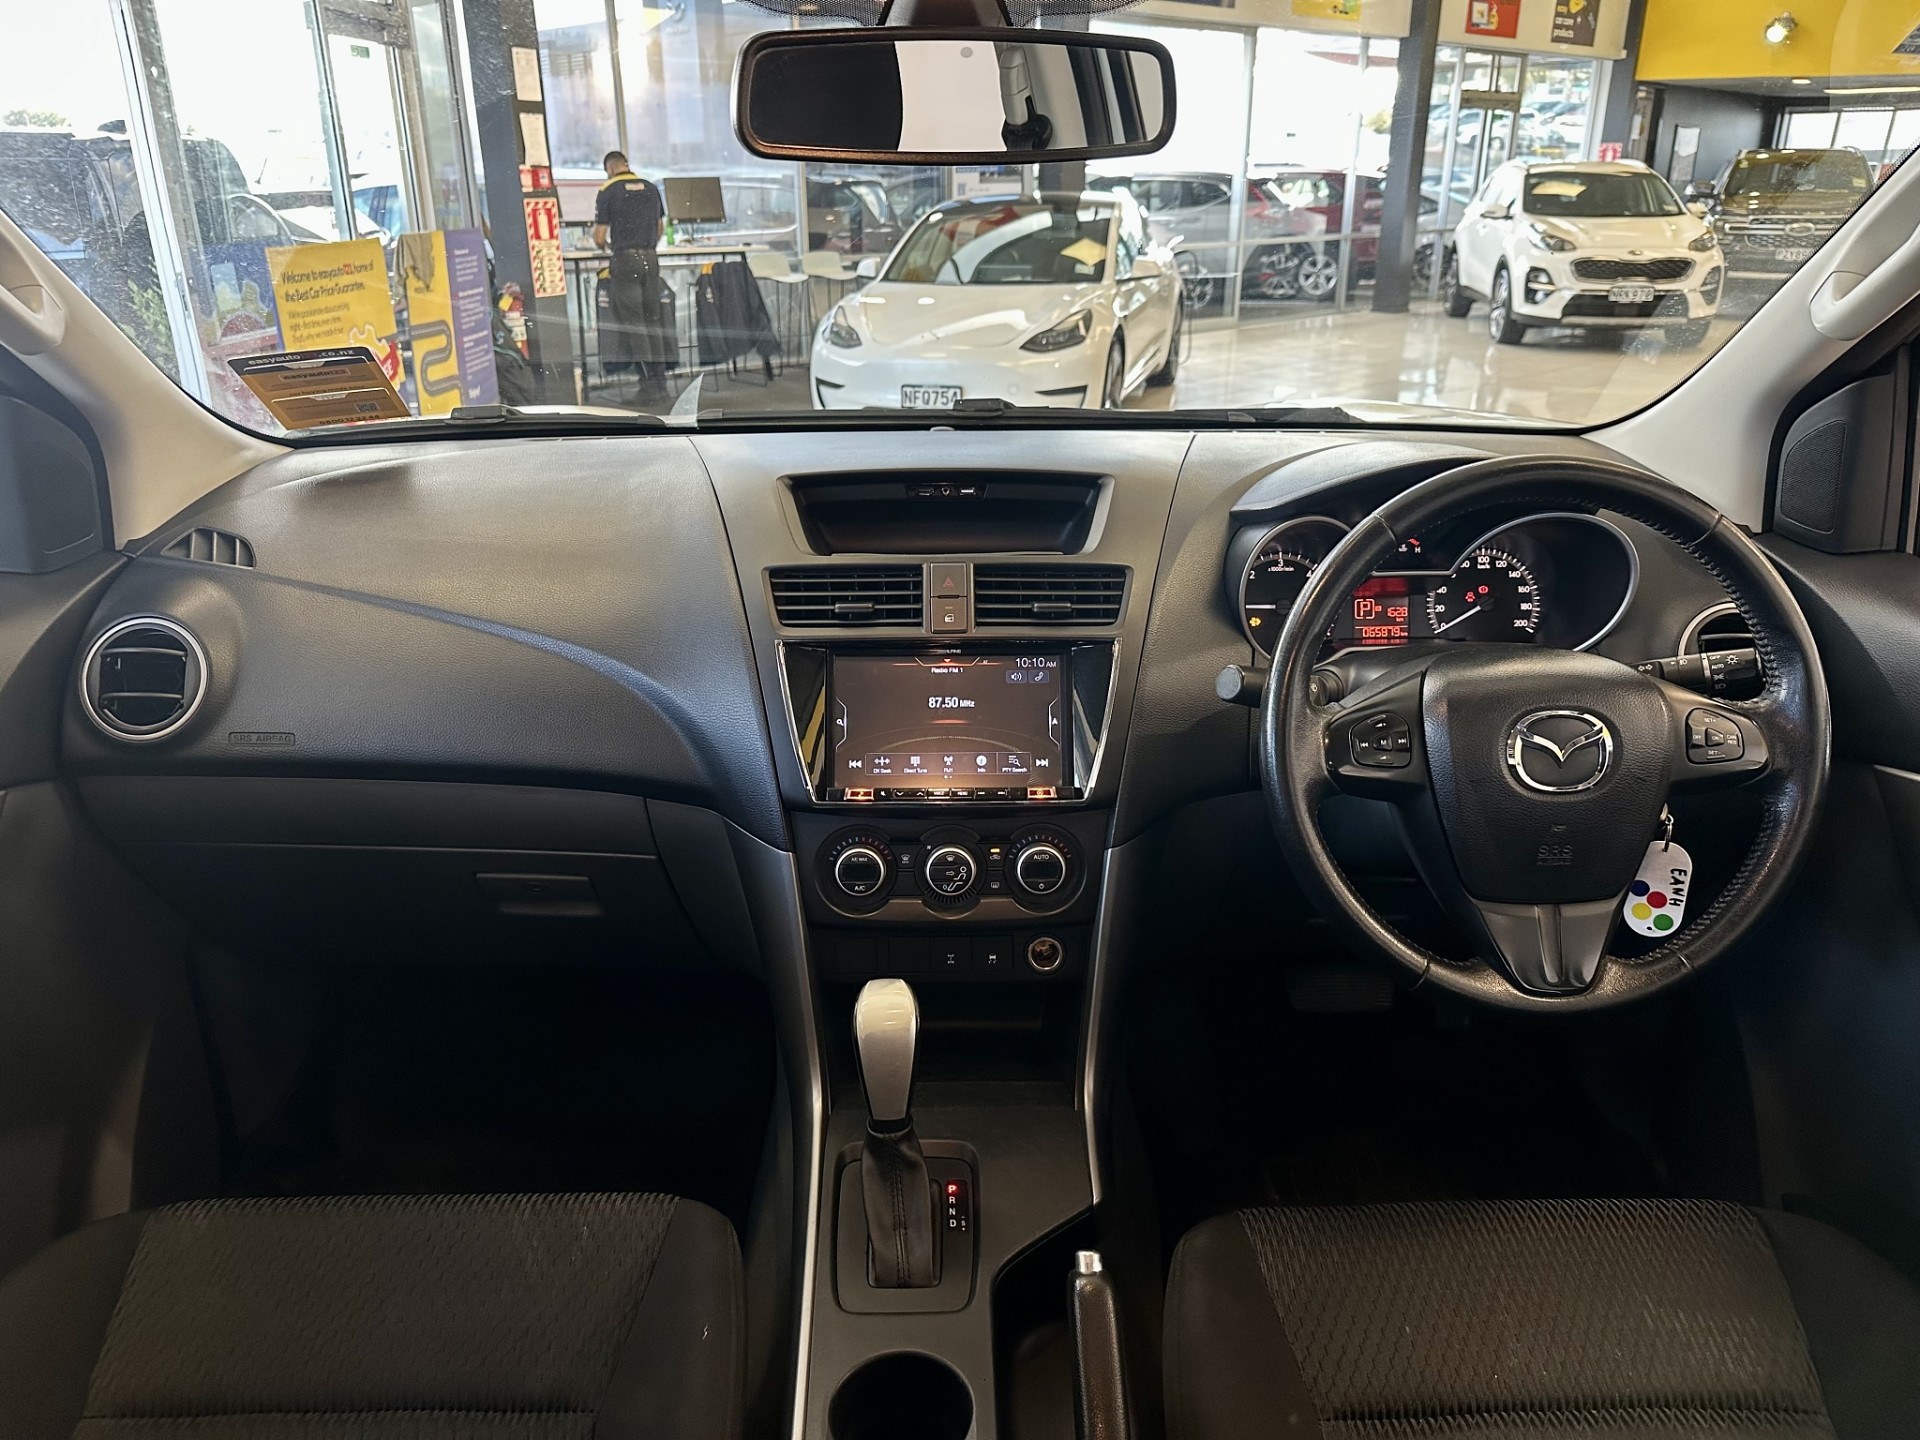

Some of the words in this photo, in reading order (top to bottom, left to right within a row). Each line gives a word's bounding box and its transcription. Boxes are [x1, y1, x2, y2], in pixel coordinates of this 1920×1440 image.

[1278, 559, 1284, 567] 3
[1495, 560, 1508, 568] 120
[1249, 570, 1255, 579] 2
[1508, 570, 1521, 578] 140
[1434, 604, 1445, 612] 20
[1513, 619, 1528, 627] 200
[1015, 657, 1045, 668] 10:10
[928, 696, 959, 708] 87.50
[960, 699, 975, 708] MHz
[233, 734, 252, 743] SRS
[256, 734, 292, 743] AIRBAG
[1537, 844, 1573, 857] SRS
[948, 1184, 957, 1194] P
[948, 1196, 956, 1204] R
[949, 1207, 956, 1216] N
[949, 1219, 957, 1227] D
